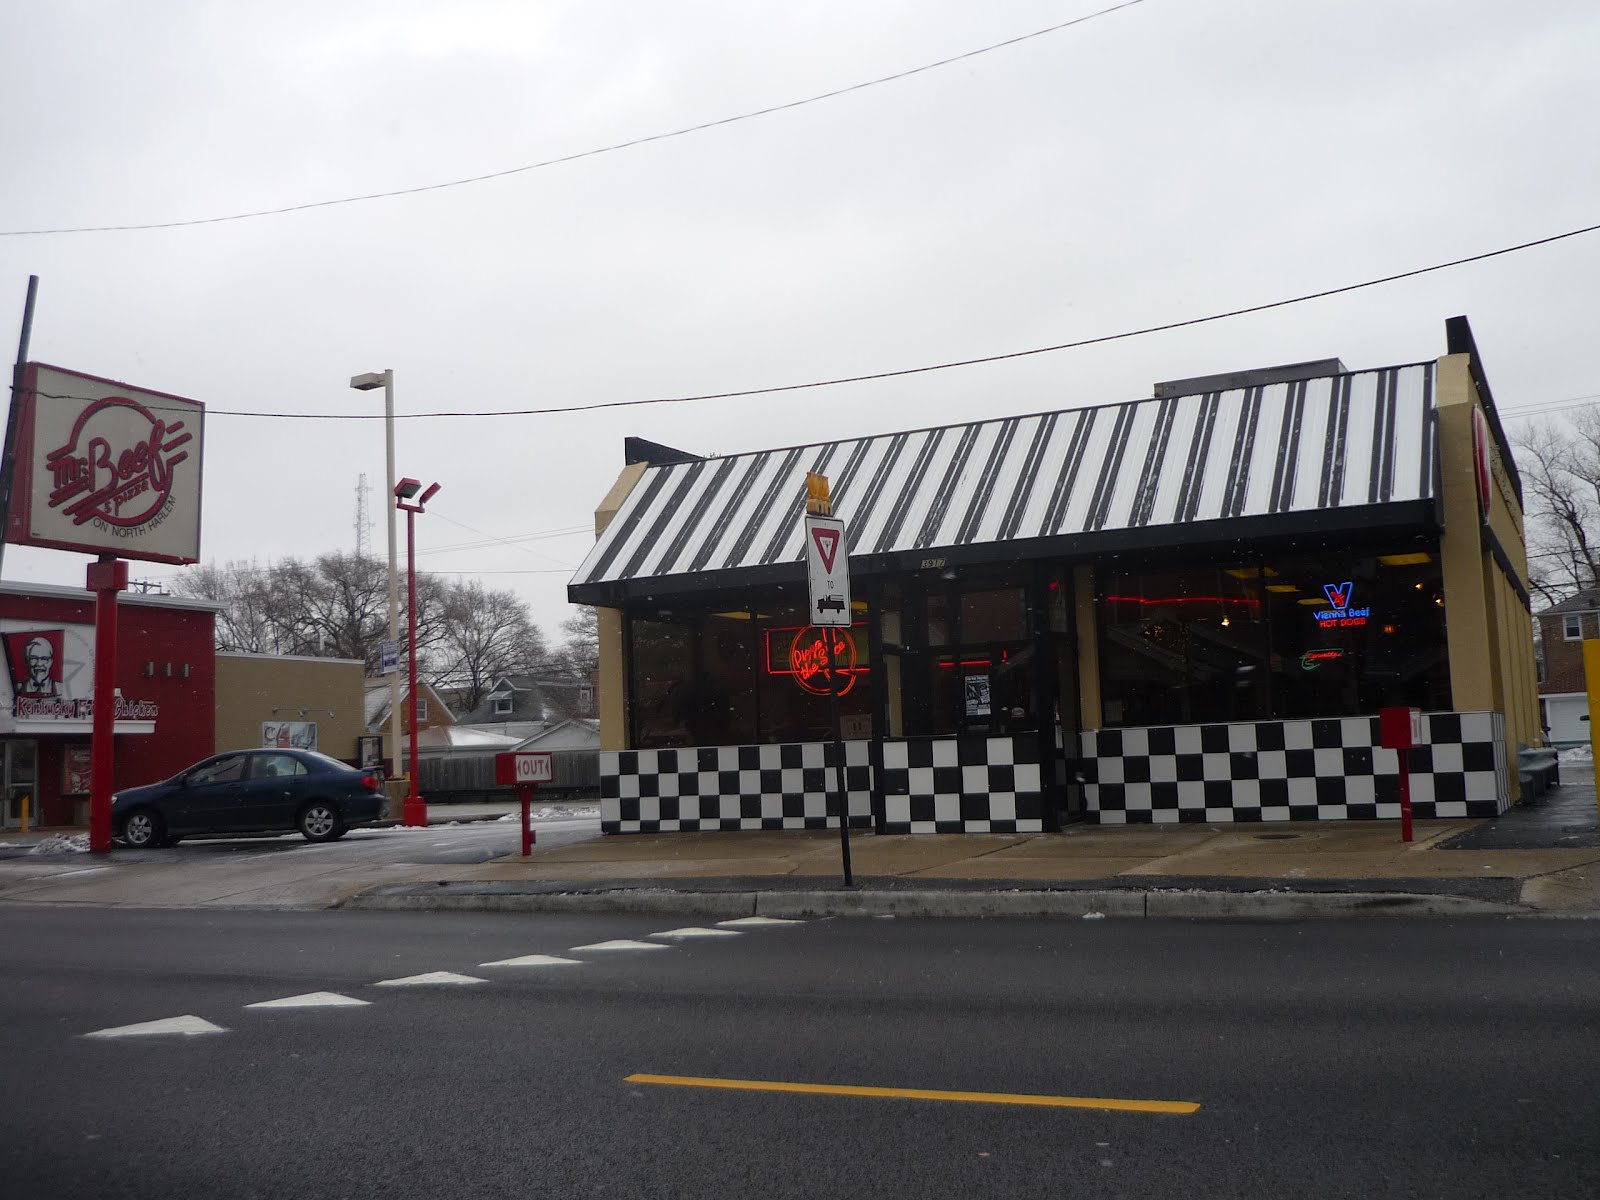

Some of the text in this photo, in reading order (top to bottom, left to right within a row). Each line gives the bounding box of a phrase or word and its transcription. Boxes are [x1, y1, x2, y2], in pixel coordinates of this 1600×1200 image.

[88, 419, 166, 492] Beef
[93, 494, 177, 539] ON NORTH HARLEM
[921, 559, 945, 569] 3917
[827, 580, 835, 589] TO
[1313, 607, 1370, 620] Vienna Beef
[1341, 618, 1366, 626] DOGS
[17, 697, 75, 717] Kentucky
[114, 698, 159, 719] Chicken
[523, 760, 544, 775] OUT
